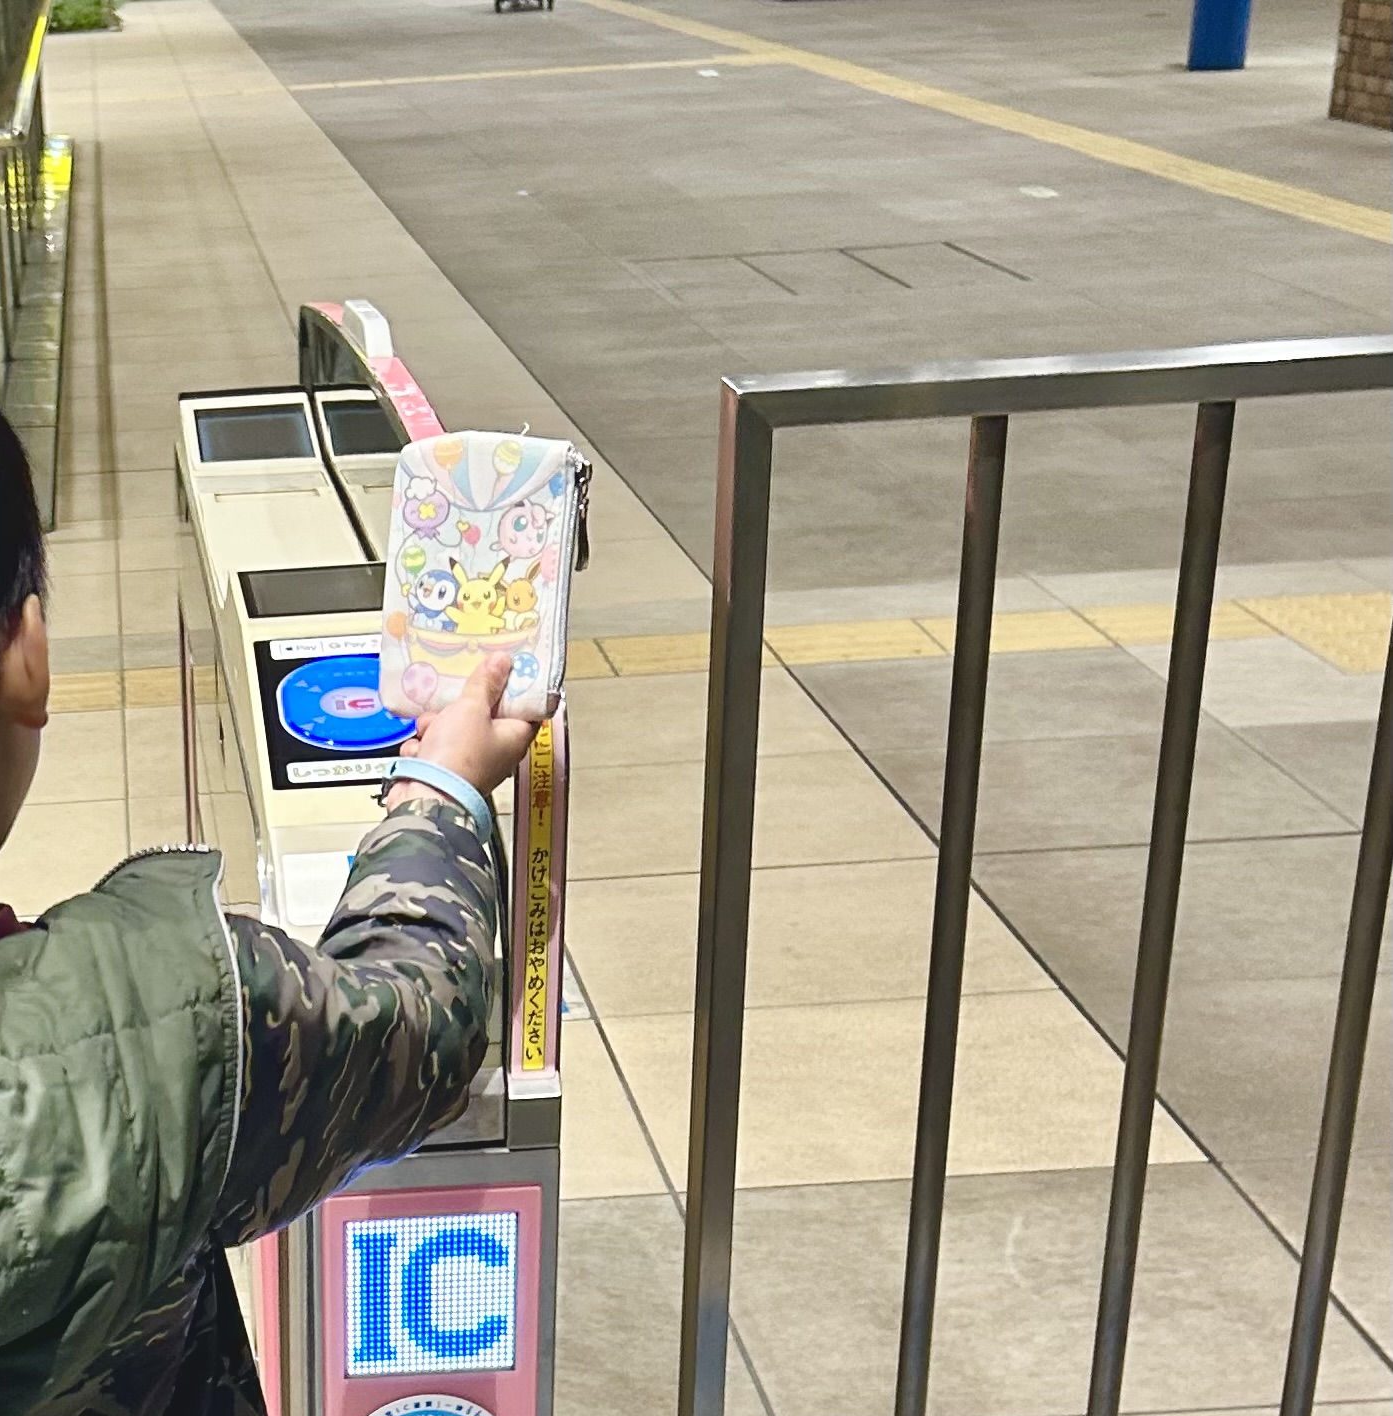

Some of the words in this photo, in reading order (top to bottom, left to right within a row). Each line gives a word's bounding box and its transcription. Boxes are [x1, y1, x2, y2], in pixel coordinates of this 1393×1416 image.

[525, 847, 550, 1060] かけこみはおやめください
[353, 1226, 510, 1363] IC
